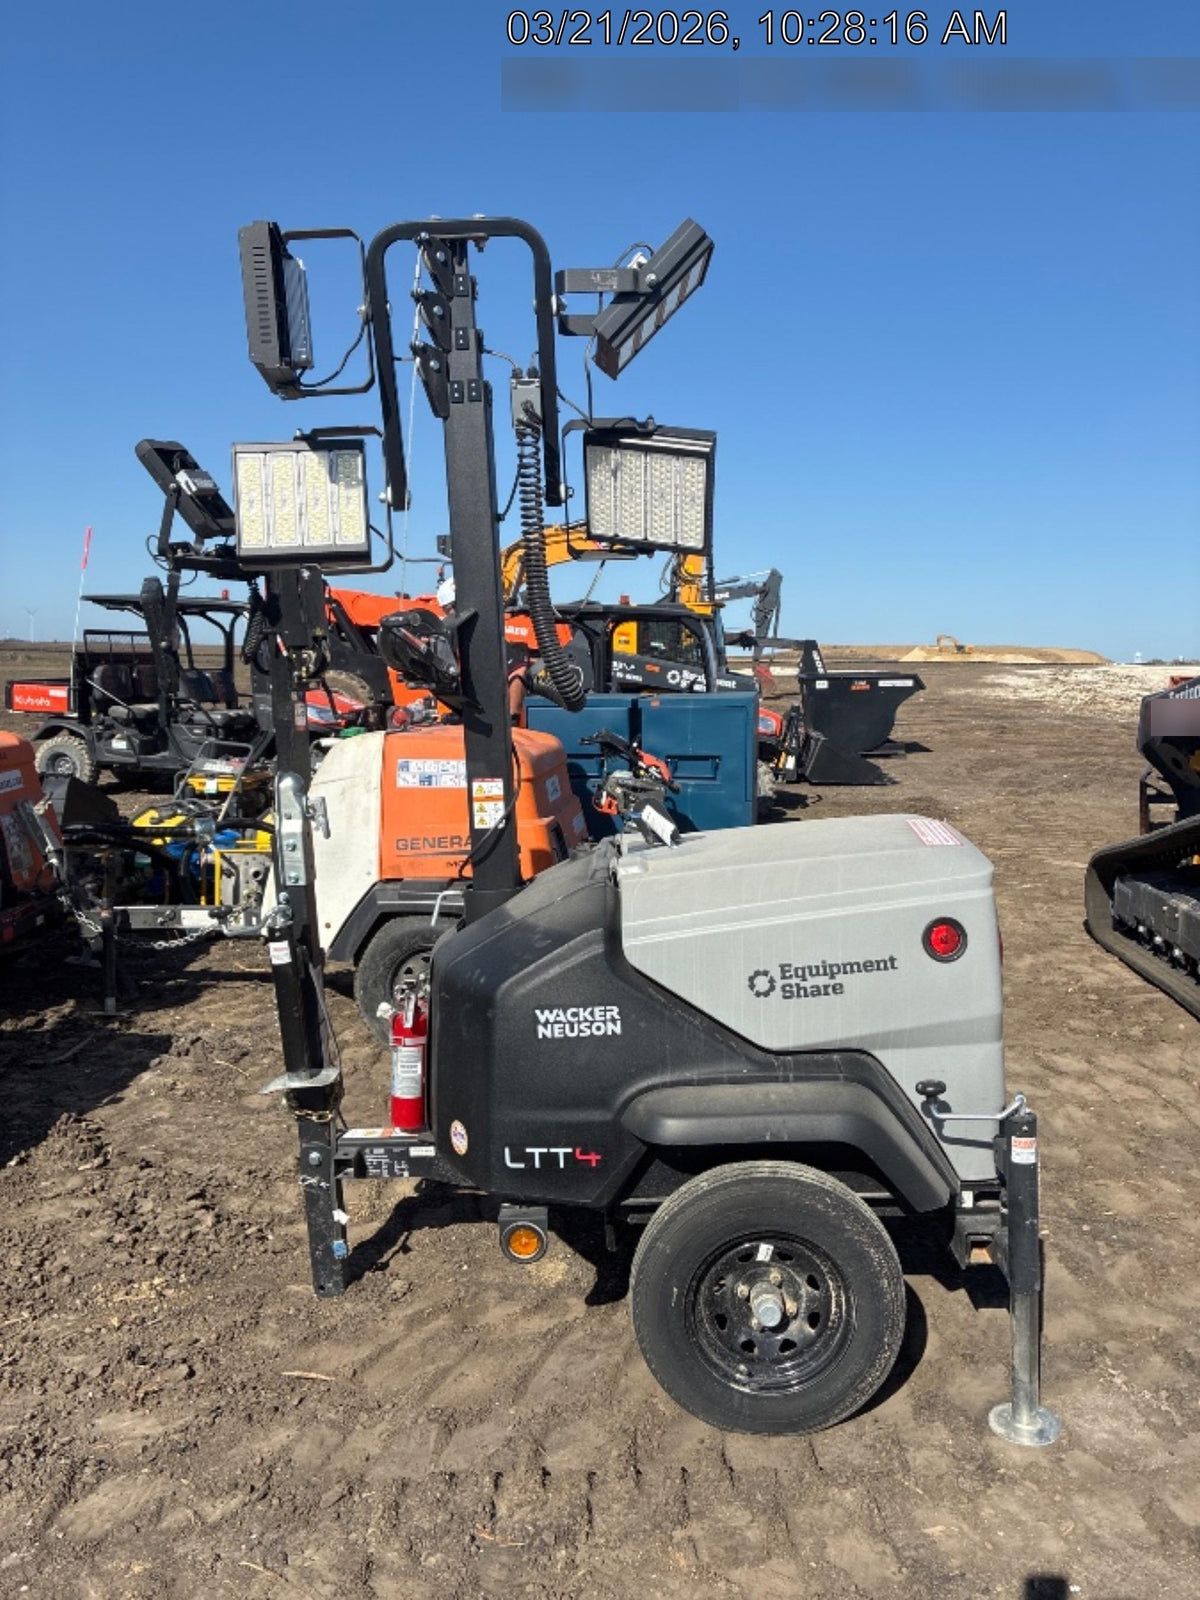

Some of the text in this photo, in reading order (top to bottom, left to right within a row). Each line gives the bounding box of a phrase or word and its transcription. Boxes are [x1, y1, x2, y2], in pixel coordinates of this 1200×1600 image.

[395, 834, 472, 851] GENERA
[778, 954, 898, 982] Equipment
[780, 982, 845, 1000] Share
[534, 1005, 621, 1024] WACKER
[536, 1020, 622, 1039] NEUSON
[504, 1145, 602, 1169] LTT4
